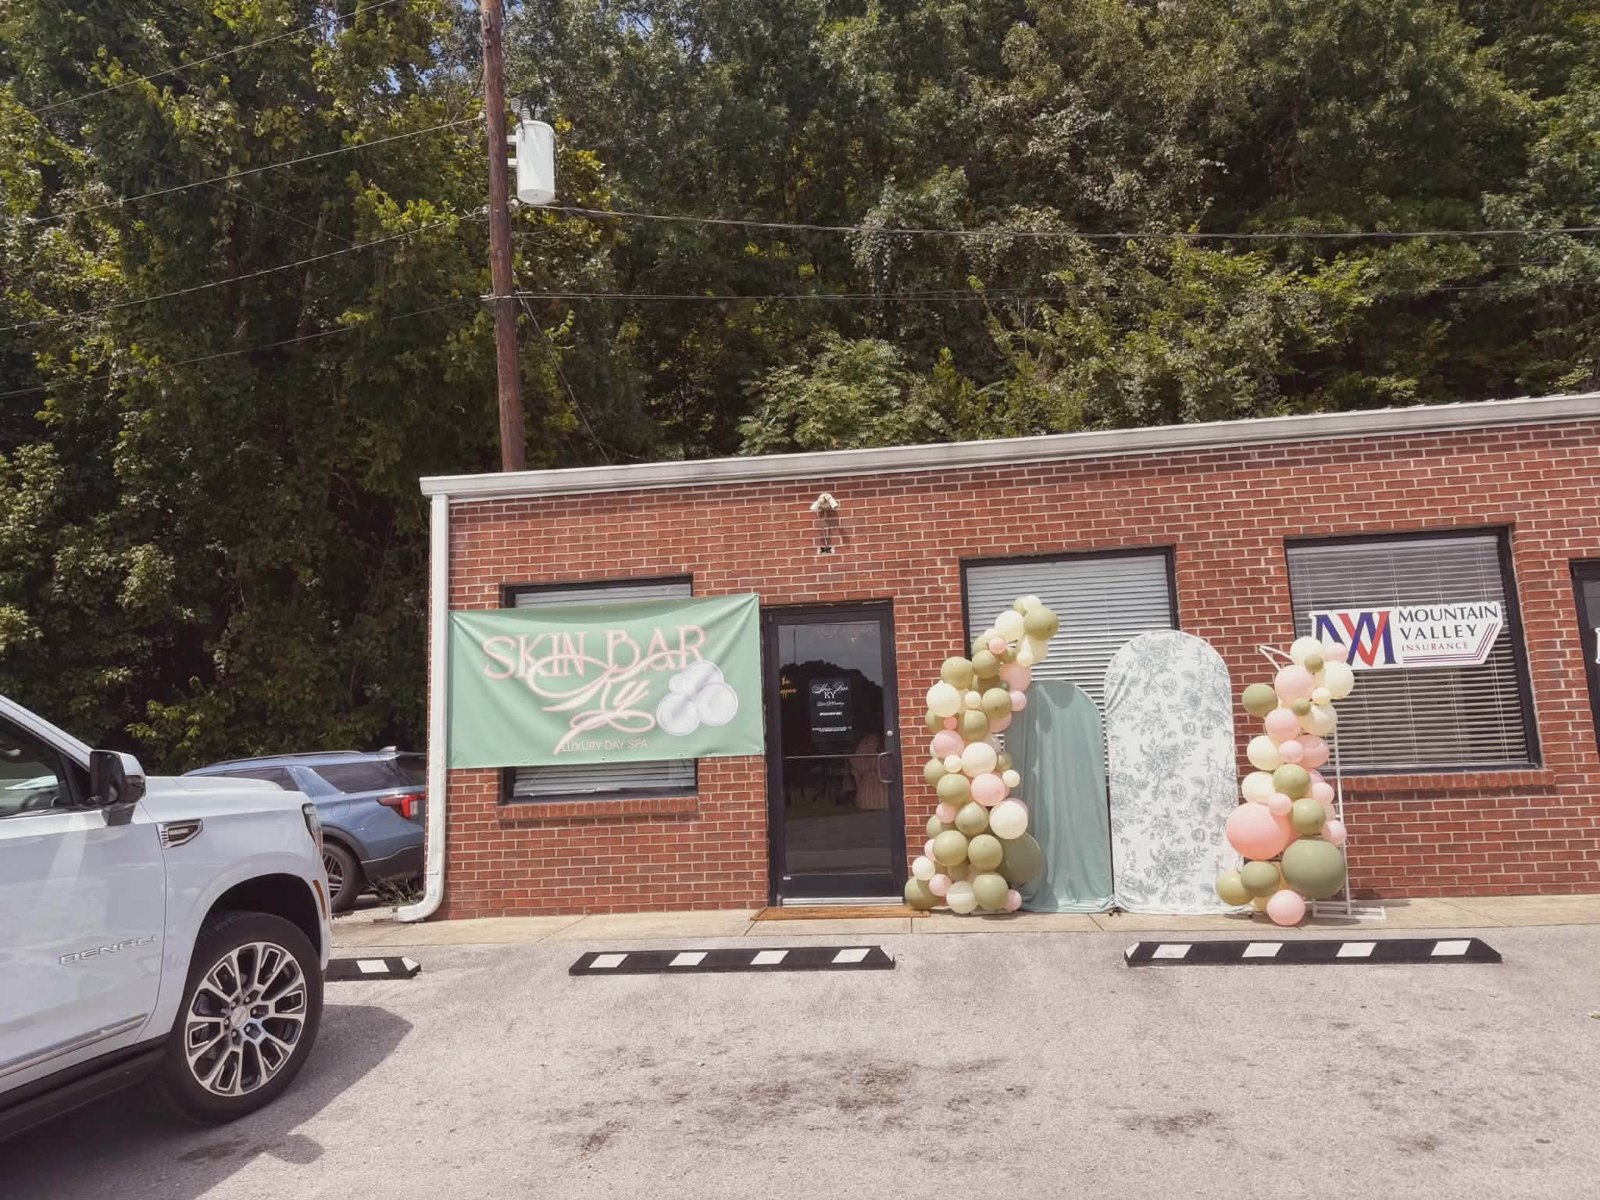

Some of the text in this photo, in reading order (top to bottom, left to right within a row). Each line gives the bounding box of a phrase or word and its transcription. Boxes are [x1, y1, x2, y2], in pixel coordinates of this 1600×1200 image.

[1399, 605, 1498, 623] MOUNTAIN
[1400, 624, 1477, 640] VALLEY
[482, 625, 706, 679] SKIN BAR
[1402, 641, 1469, 652] INSURANCE
[824, 691, 837, 699] KY
[562, 739, 648, 752] LUXURY DAY SPA
[59, 934, 156, 966] DENALI
